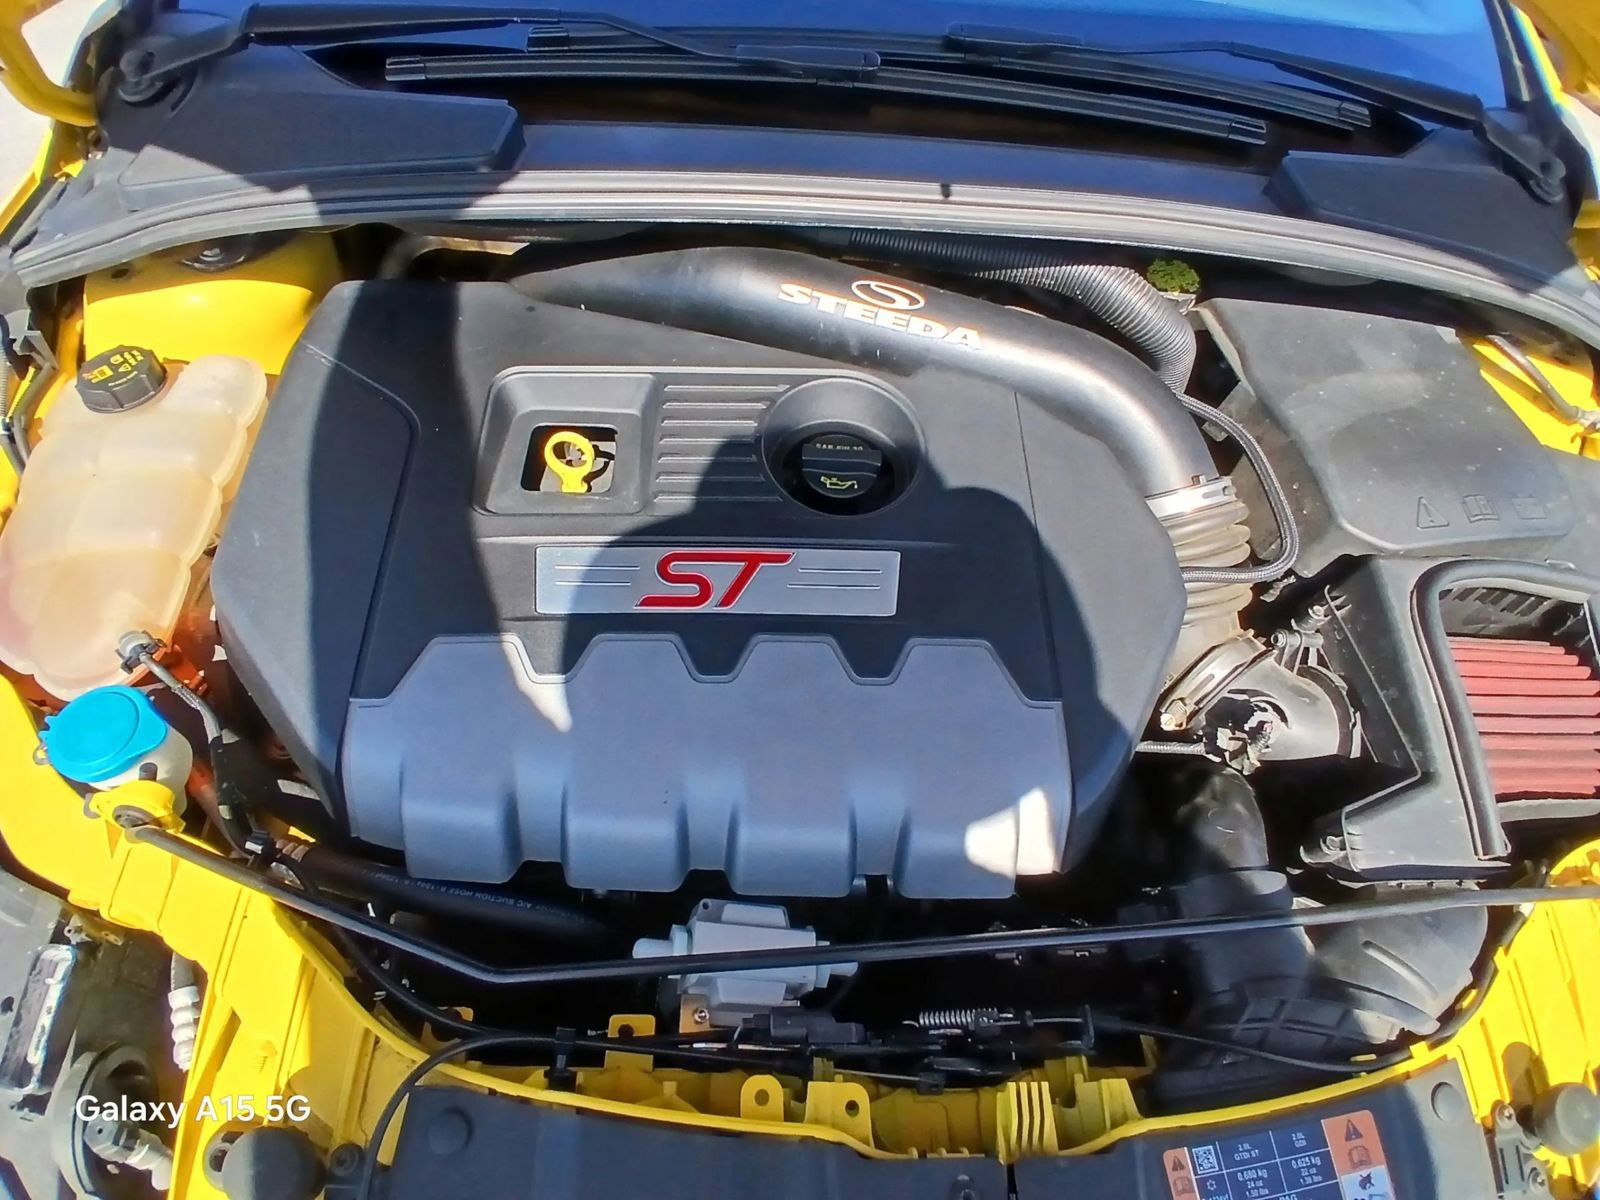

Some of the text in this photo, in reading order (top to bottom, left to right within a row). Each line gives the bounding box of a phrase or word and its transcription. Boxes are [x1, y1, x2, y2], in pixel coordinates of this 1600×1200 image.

[778, 284, 984, 350] STEEDA
[633, 550, 796, 610] ST
[475, 892, 515, 905] SUCTION
[1311, 1156, 1321, 1166] kg
[1257, 1169, 1268, 1178] kg
